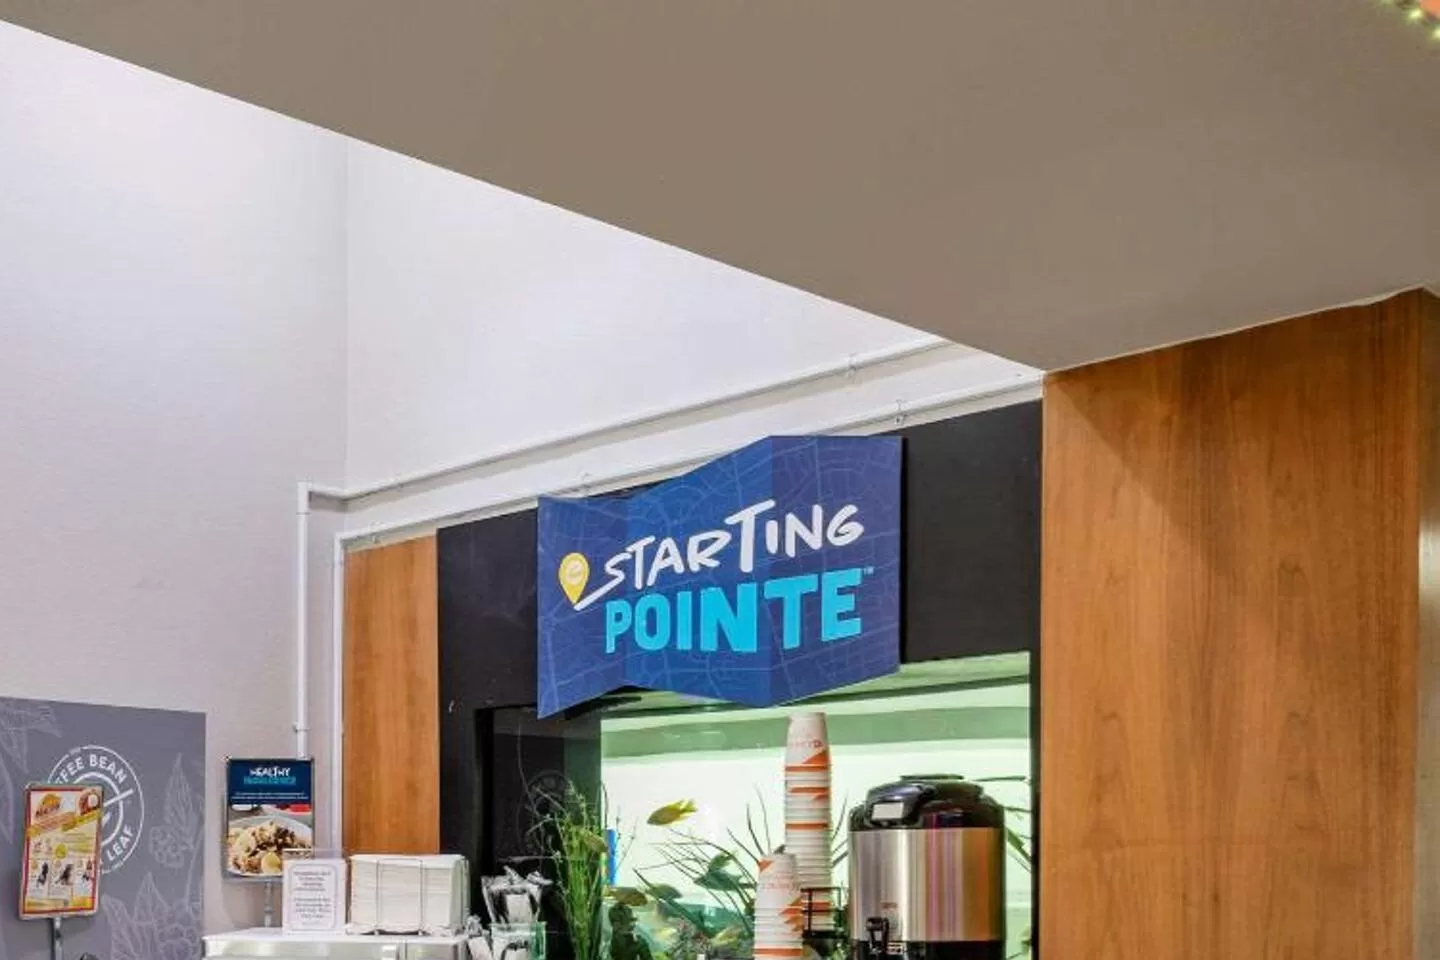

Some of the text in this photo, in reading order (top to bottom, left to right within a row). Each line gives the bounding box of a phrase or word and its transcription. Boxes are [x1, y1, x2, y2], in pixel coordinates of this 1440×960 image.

[573, 499, 864, 611] STARTING
[605, 567, 861, 654] POINTE
[55, 753, 127, 784] FEE BEAN
[249, 765, 291, 778] HEALTHY
[106, 824, 134, 860] LEAF
